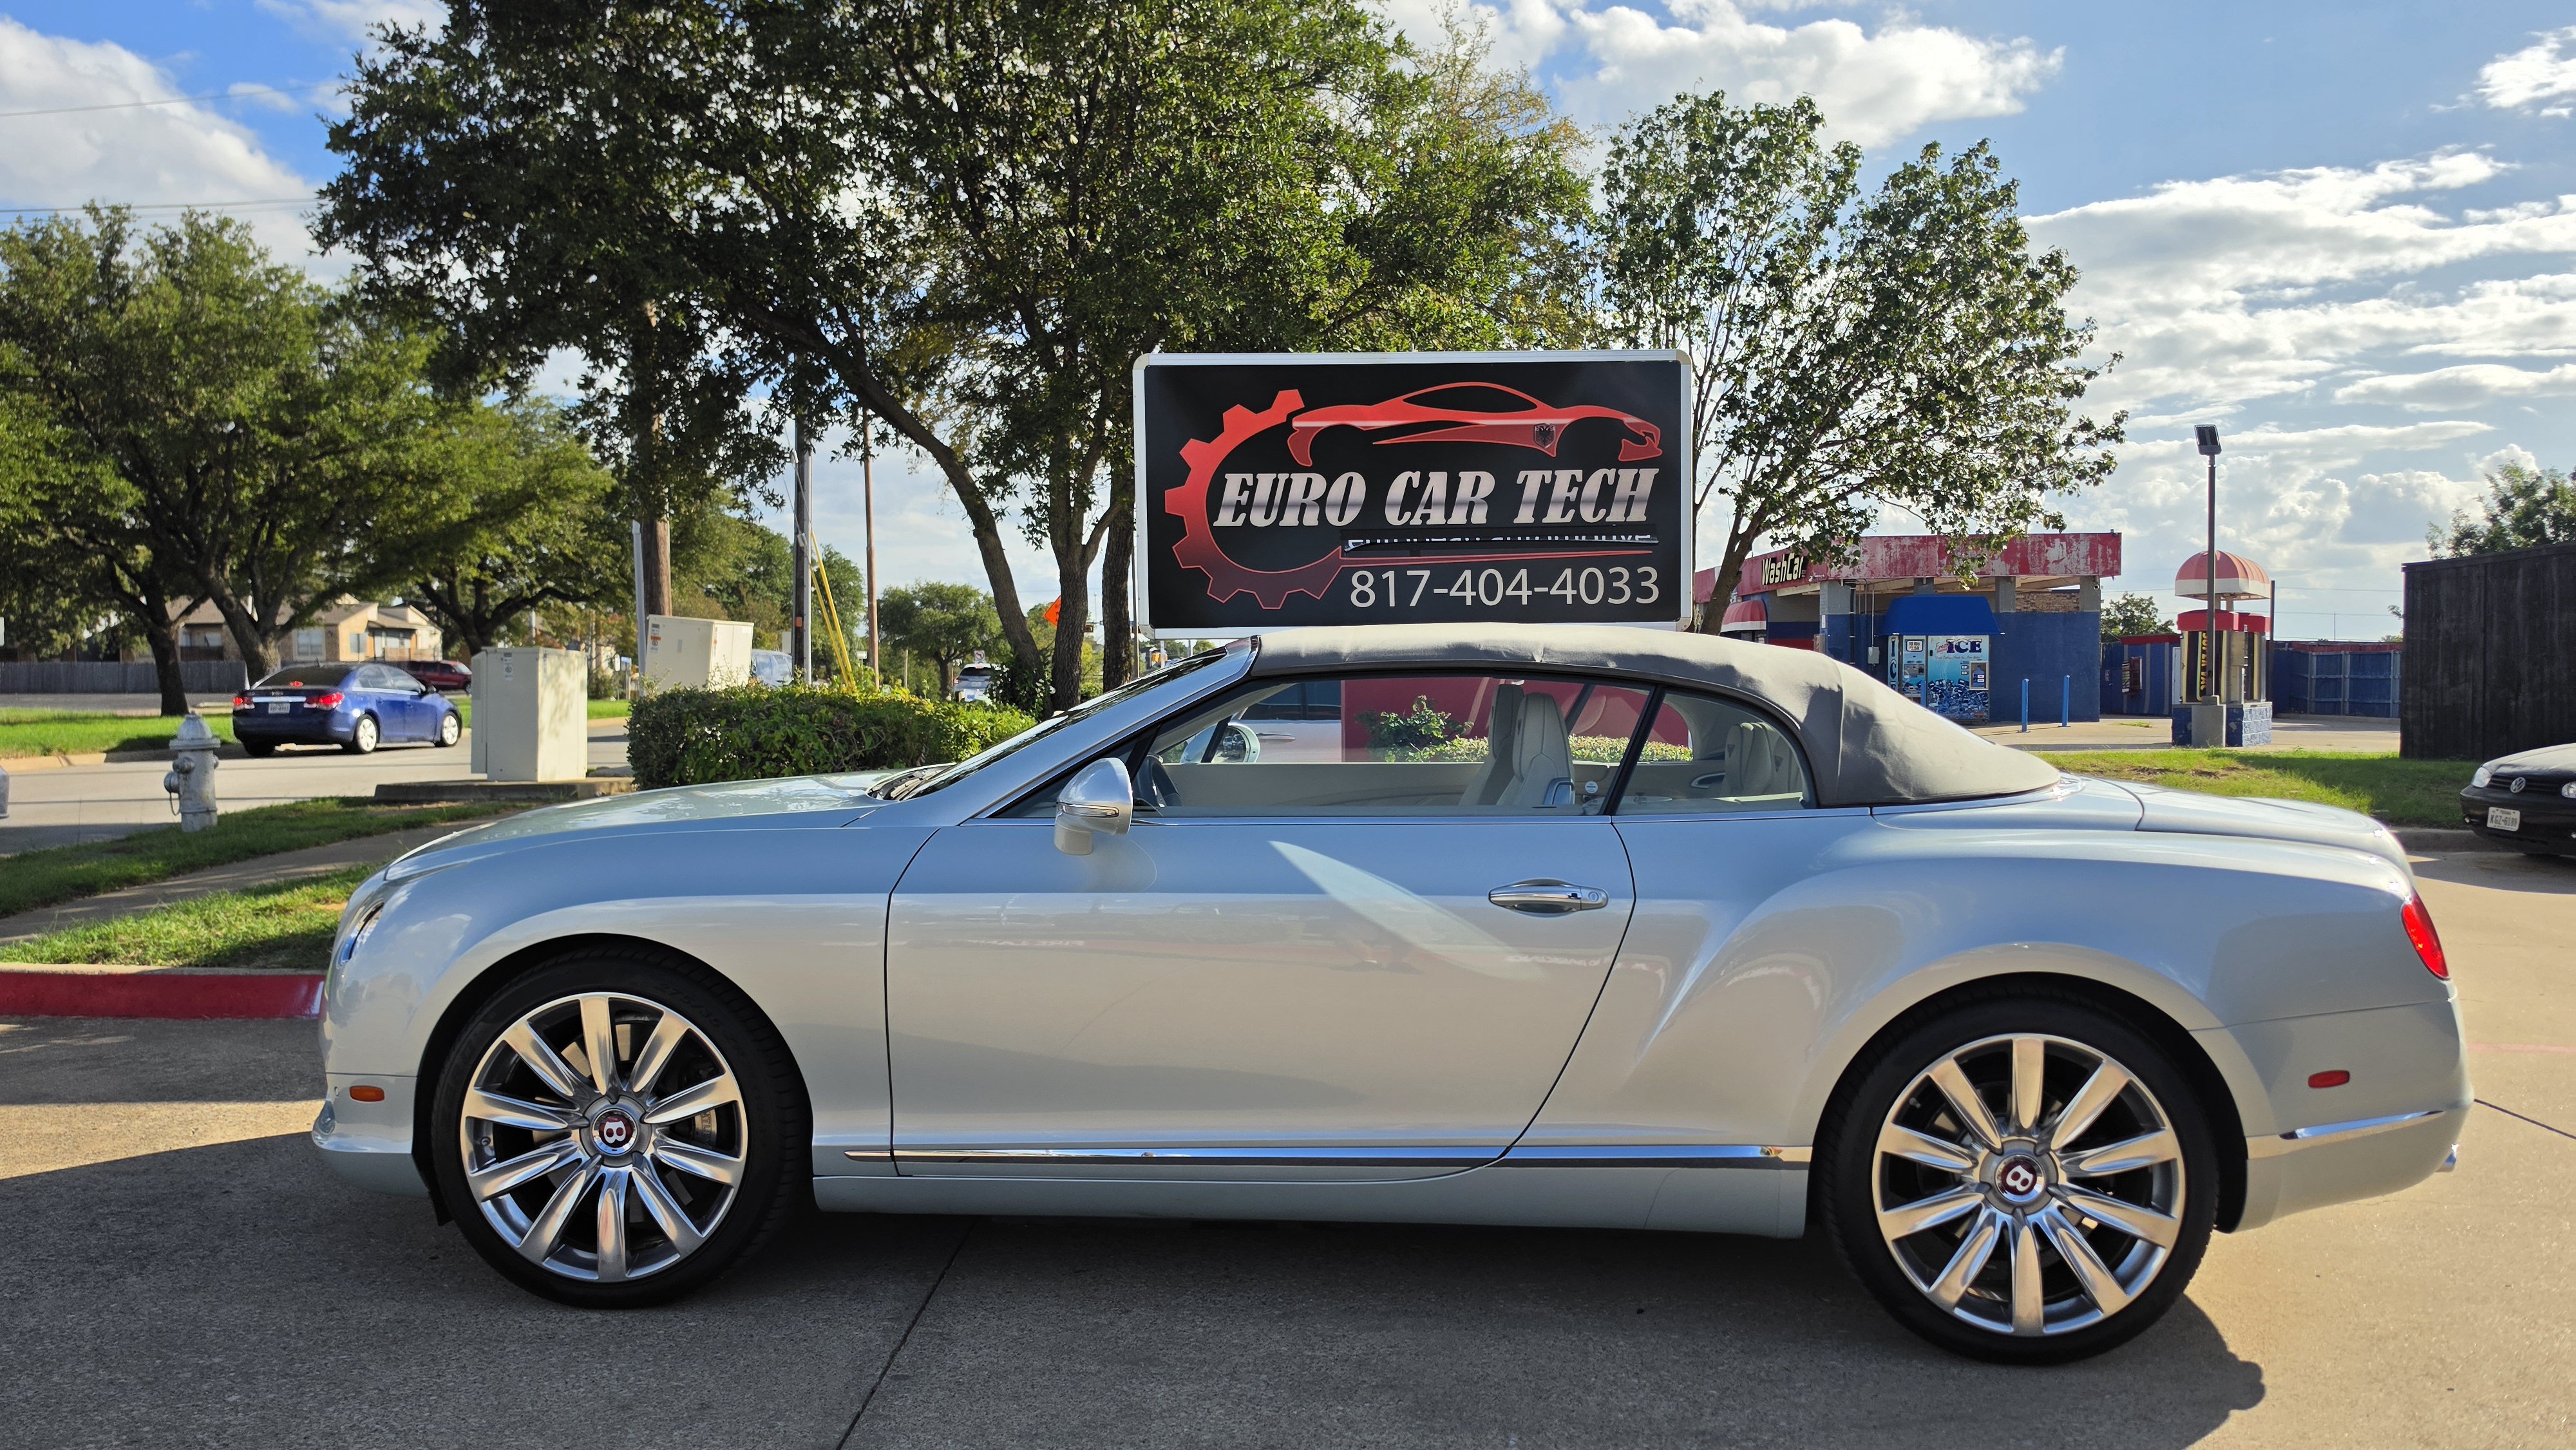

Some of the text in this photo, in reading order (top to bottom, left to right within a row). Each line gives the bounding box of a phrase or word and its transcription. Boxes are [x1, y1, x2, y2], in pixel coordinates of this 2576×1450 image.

[1213, 468, 1660, 527] EURO CAR TECH
[1350, 566, 1660, 608] 817-404-4033
[1946, 639, 1982, 653] ICE
